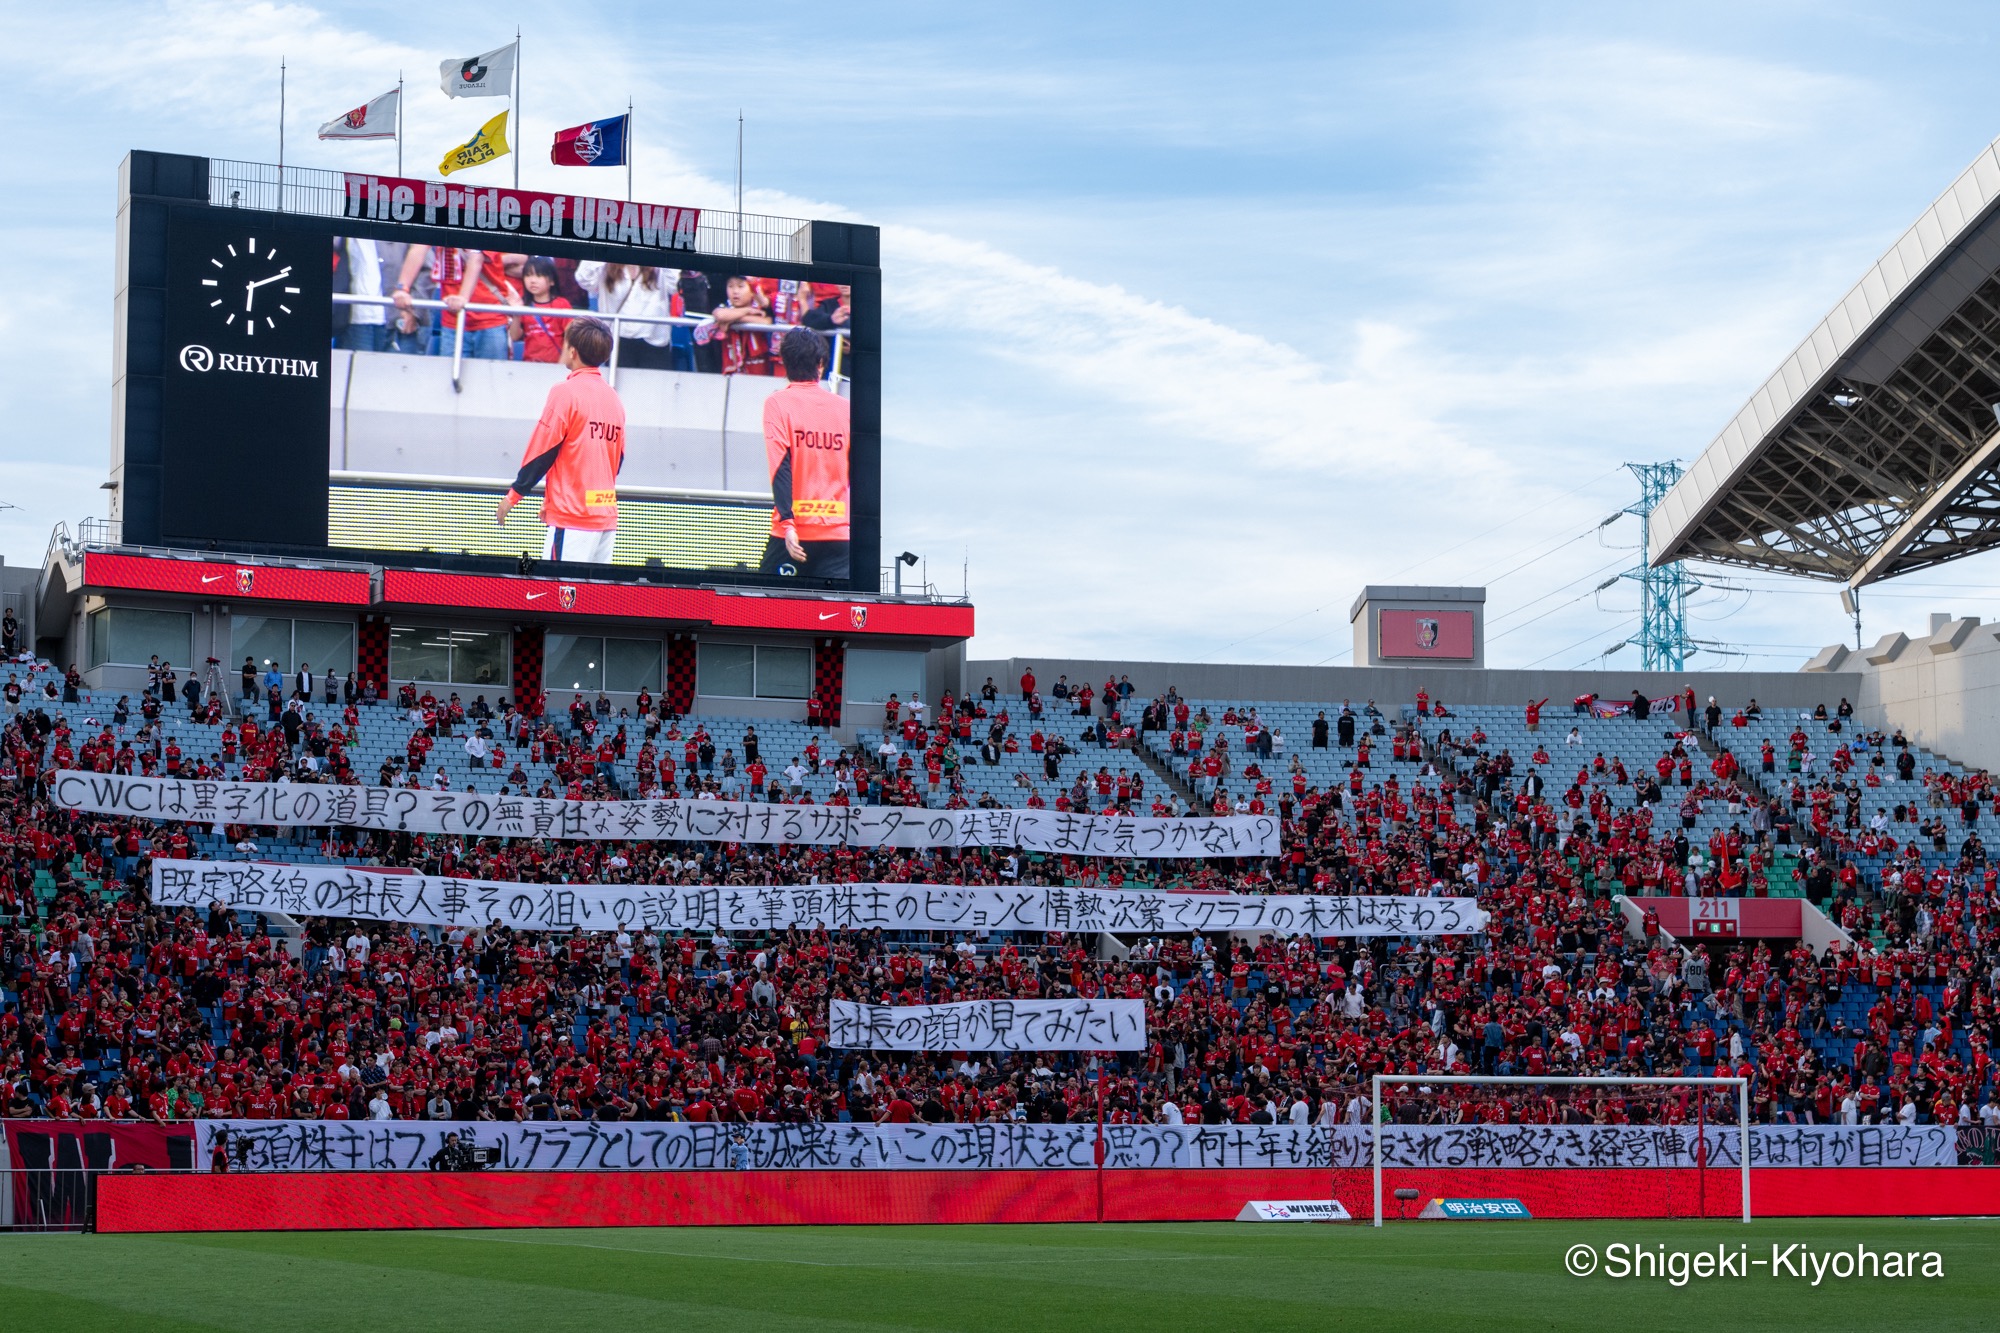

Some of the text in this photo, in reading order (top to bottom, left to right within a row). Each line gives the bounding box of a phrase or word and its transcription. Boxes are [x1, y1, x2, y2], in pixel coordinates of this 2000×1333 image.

[346, 173, 700, 251] The Pride of URAWA
[218, 353, 319, 378] RHYTHM
[794, 430, 843, 450] POLUS
[798, 503, 838, 514] DHL
[1699, 900, 1729, 918] 211
[832, 1002, 1137, 1050] 社長の顔が見てみたい
[1286, 1204, 1340, 1214] WINNER
[1446, 1202, 1523, 1214] 明治安田
